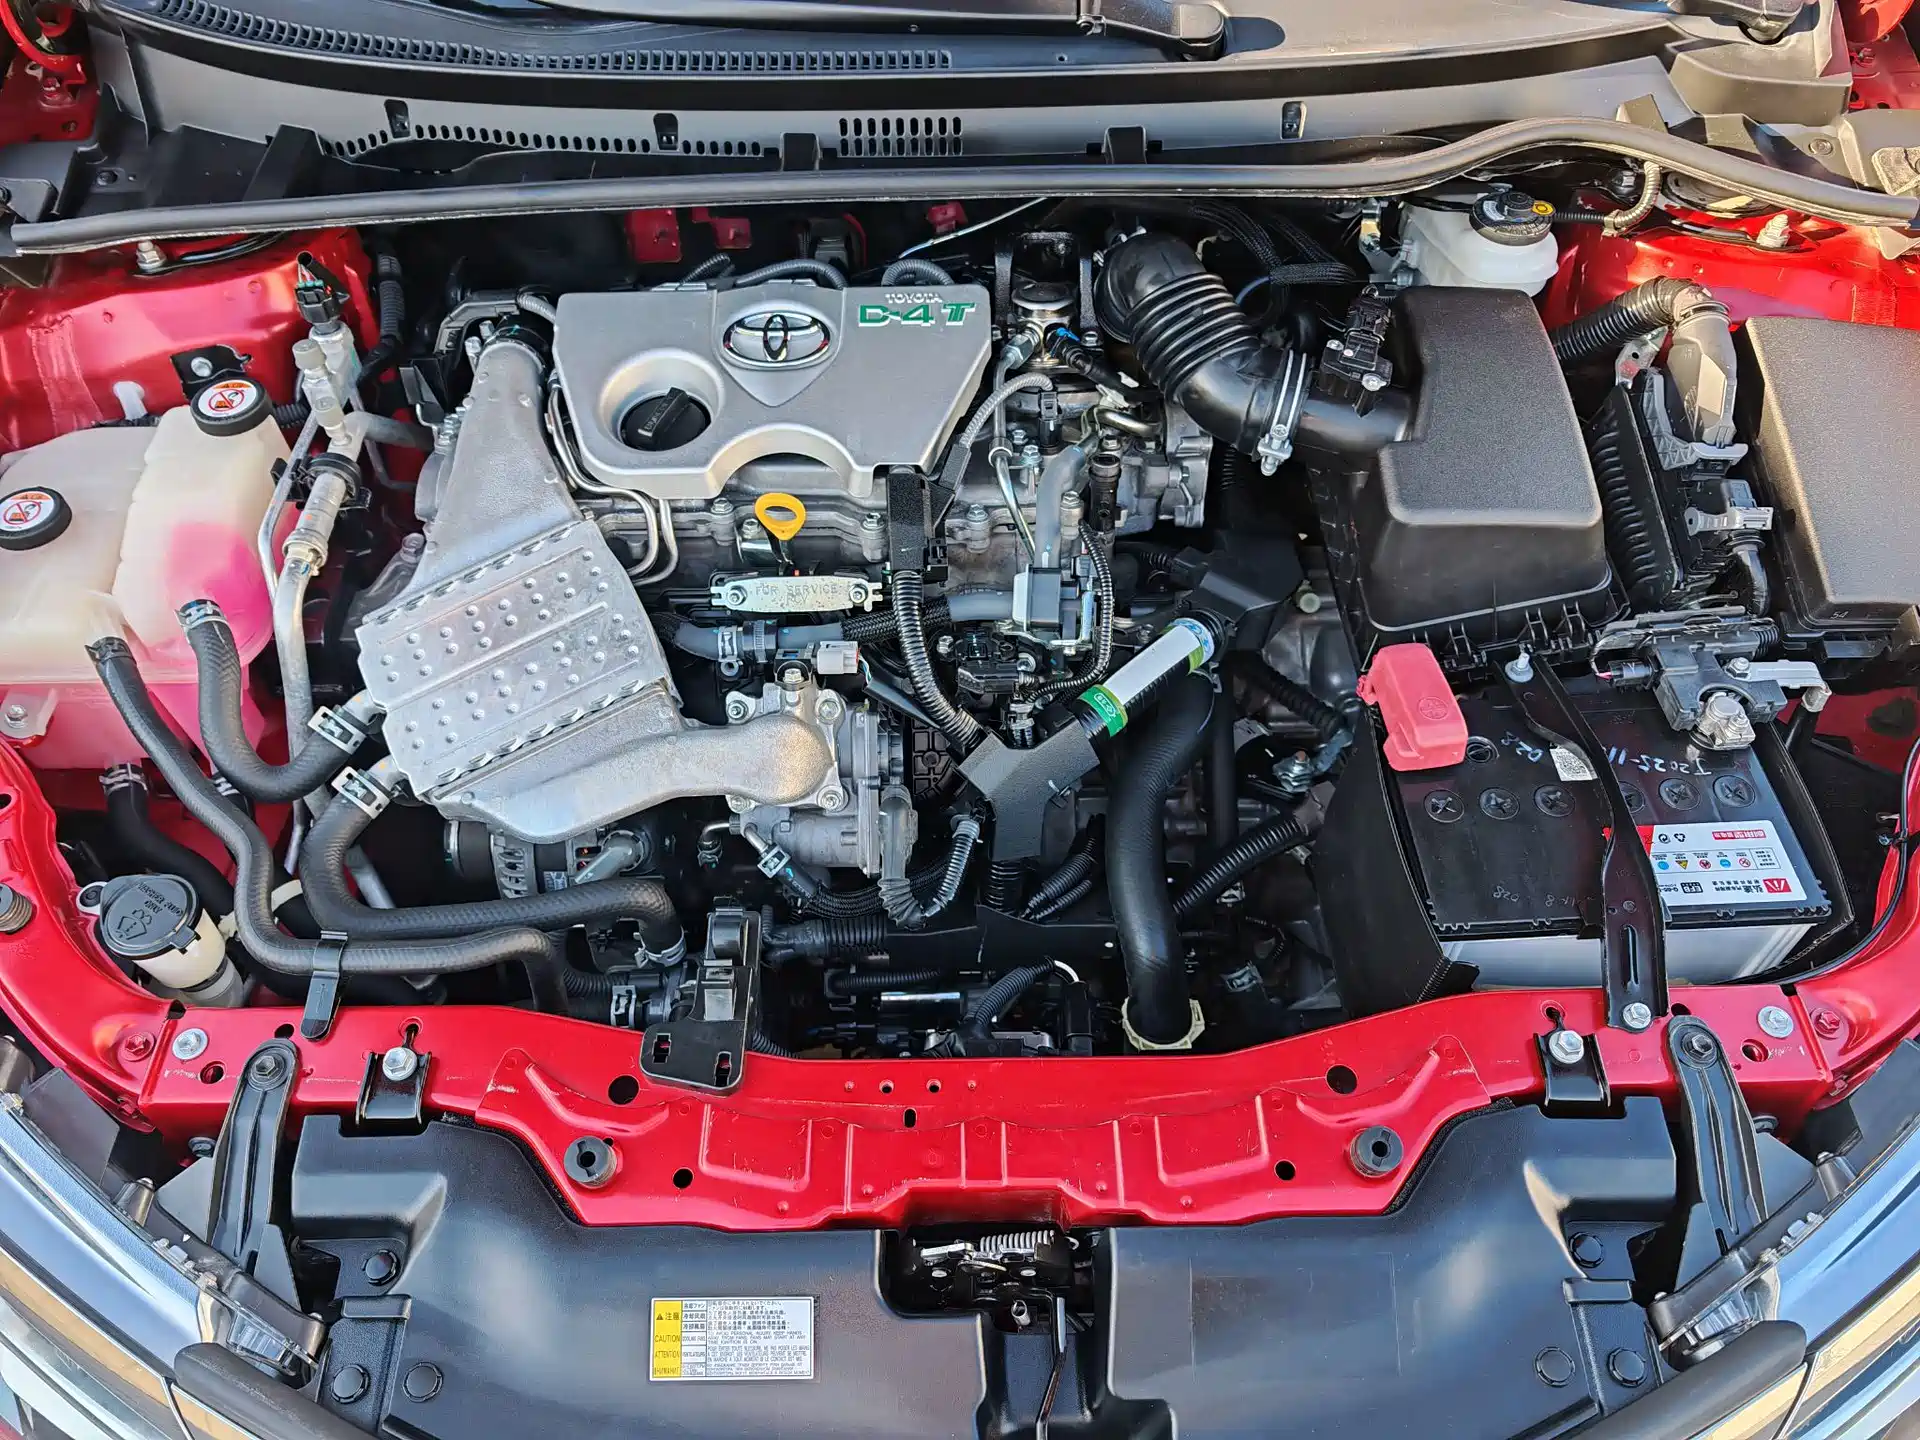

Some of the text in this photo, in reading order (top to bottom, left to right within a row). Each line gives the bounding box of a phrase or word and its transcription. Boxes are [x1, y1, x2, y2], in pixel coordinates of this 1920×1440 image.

[885, 293, 942, 304] TOYOTA
[786, 582, 838, 595] SERVICE
[654, 1334, 680, 1343] CAUTION
